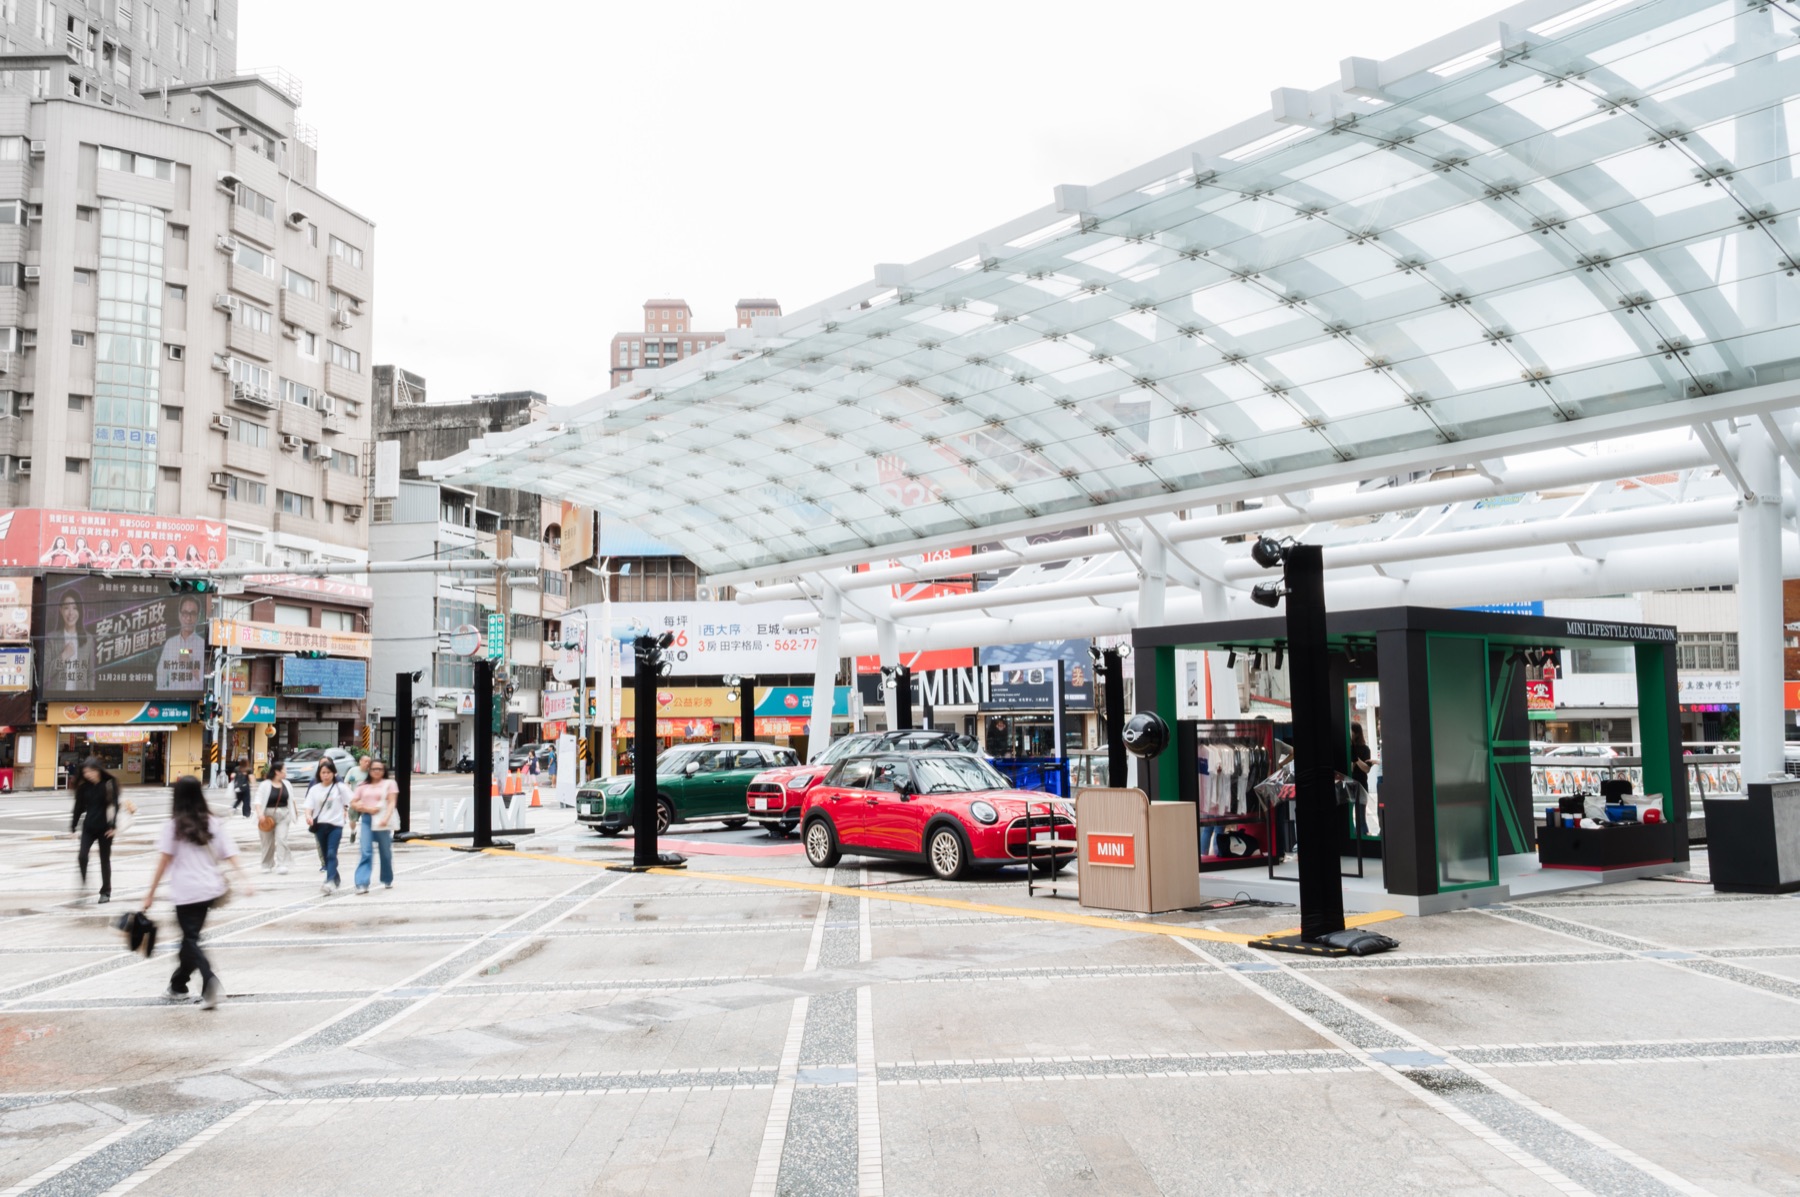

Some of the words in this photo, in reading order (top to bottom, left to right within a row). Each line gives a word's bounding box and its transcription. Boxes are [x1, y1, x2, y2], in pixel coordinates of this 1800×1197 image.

[96, 601, 166, 641] 安心市政
[1566, 621, 1586, 636] MINI
[1587, 623, 1629, 639] LIFESTYLE
[1629, 626, 1677, 641] COLLECTION.
[918, 665, 992, 706] MINI
[673, 697, 713, 707] 公益彩券
[1097, 842, 1125, 857] MINI
